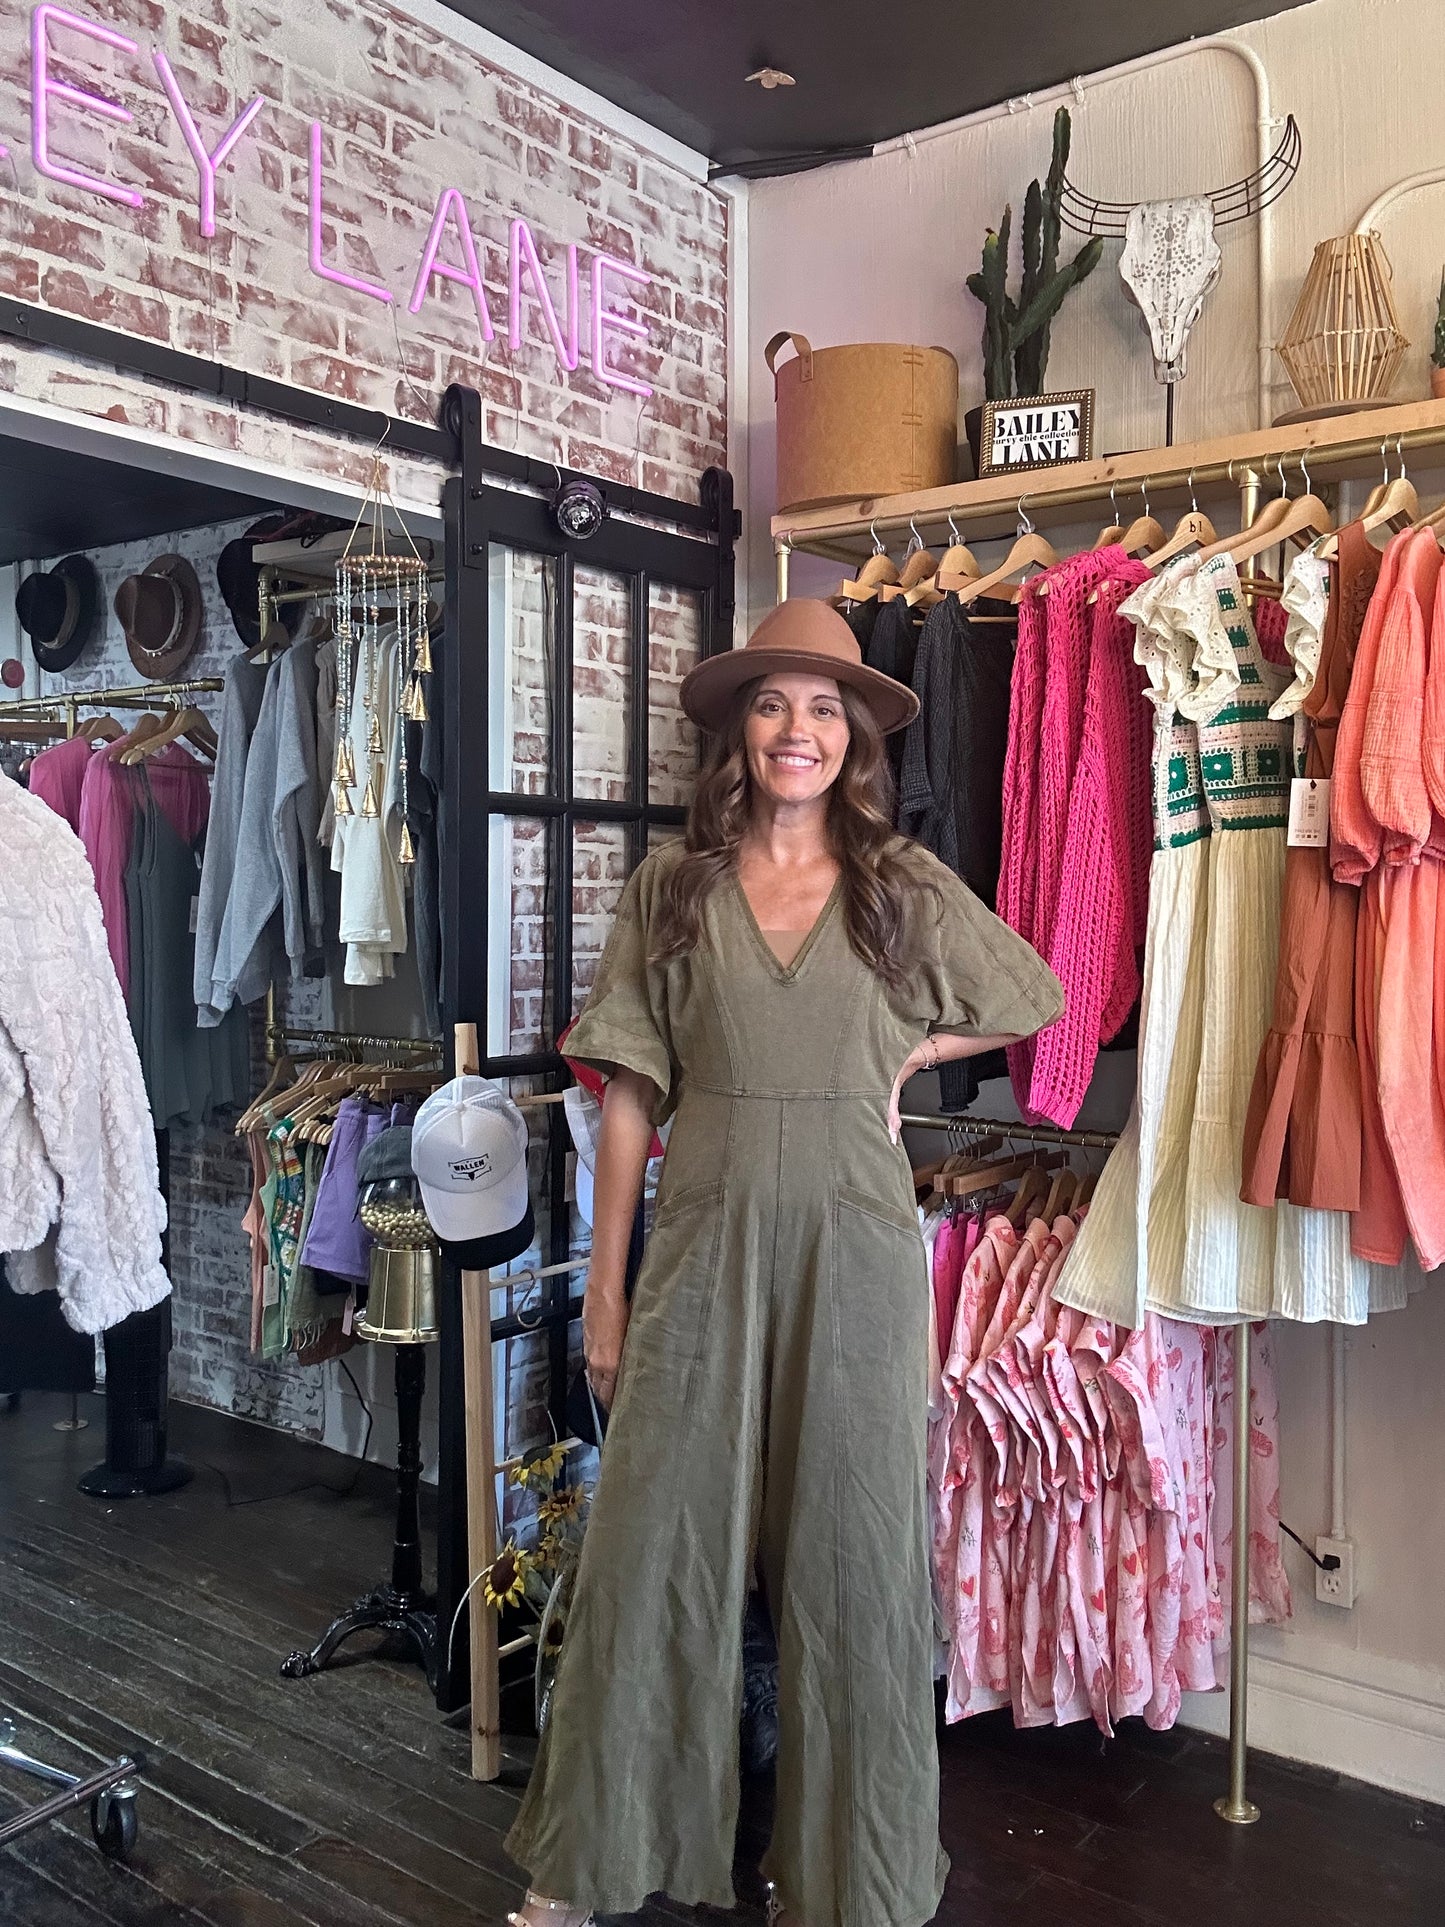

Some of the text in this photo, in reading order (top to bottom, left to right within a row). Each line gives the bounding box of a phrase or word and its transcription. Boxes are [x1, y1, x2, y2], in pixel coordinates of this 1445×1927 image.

[0, 4, 654, 400] EY LANE
[994, 409, 1080, 438] BAILEY
[1019, 433, 1038, 442] chic
[1003, 439, 1070, 464] LANE
[453, 1159, 485, 1171] WALLEN
